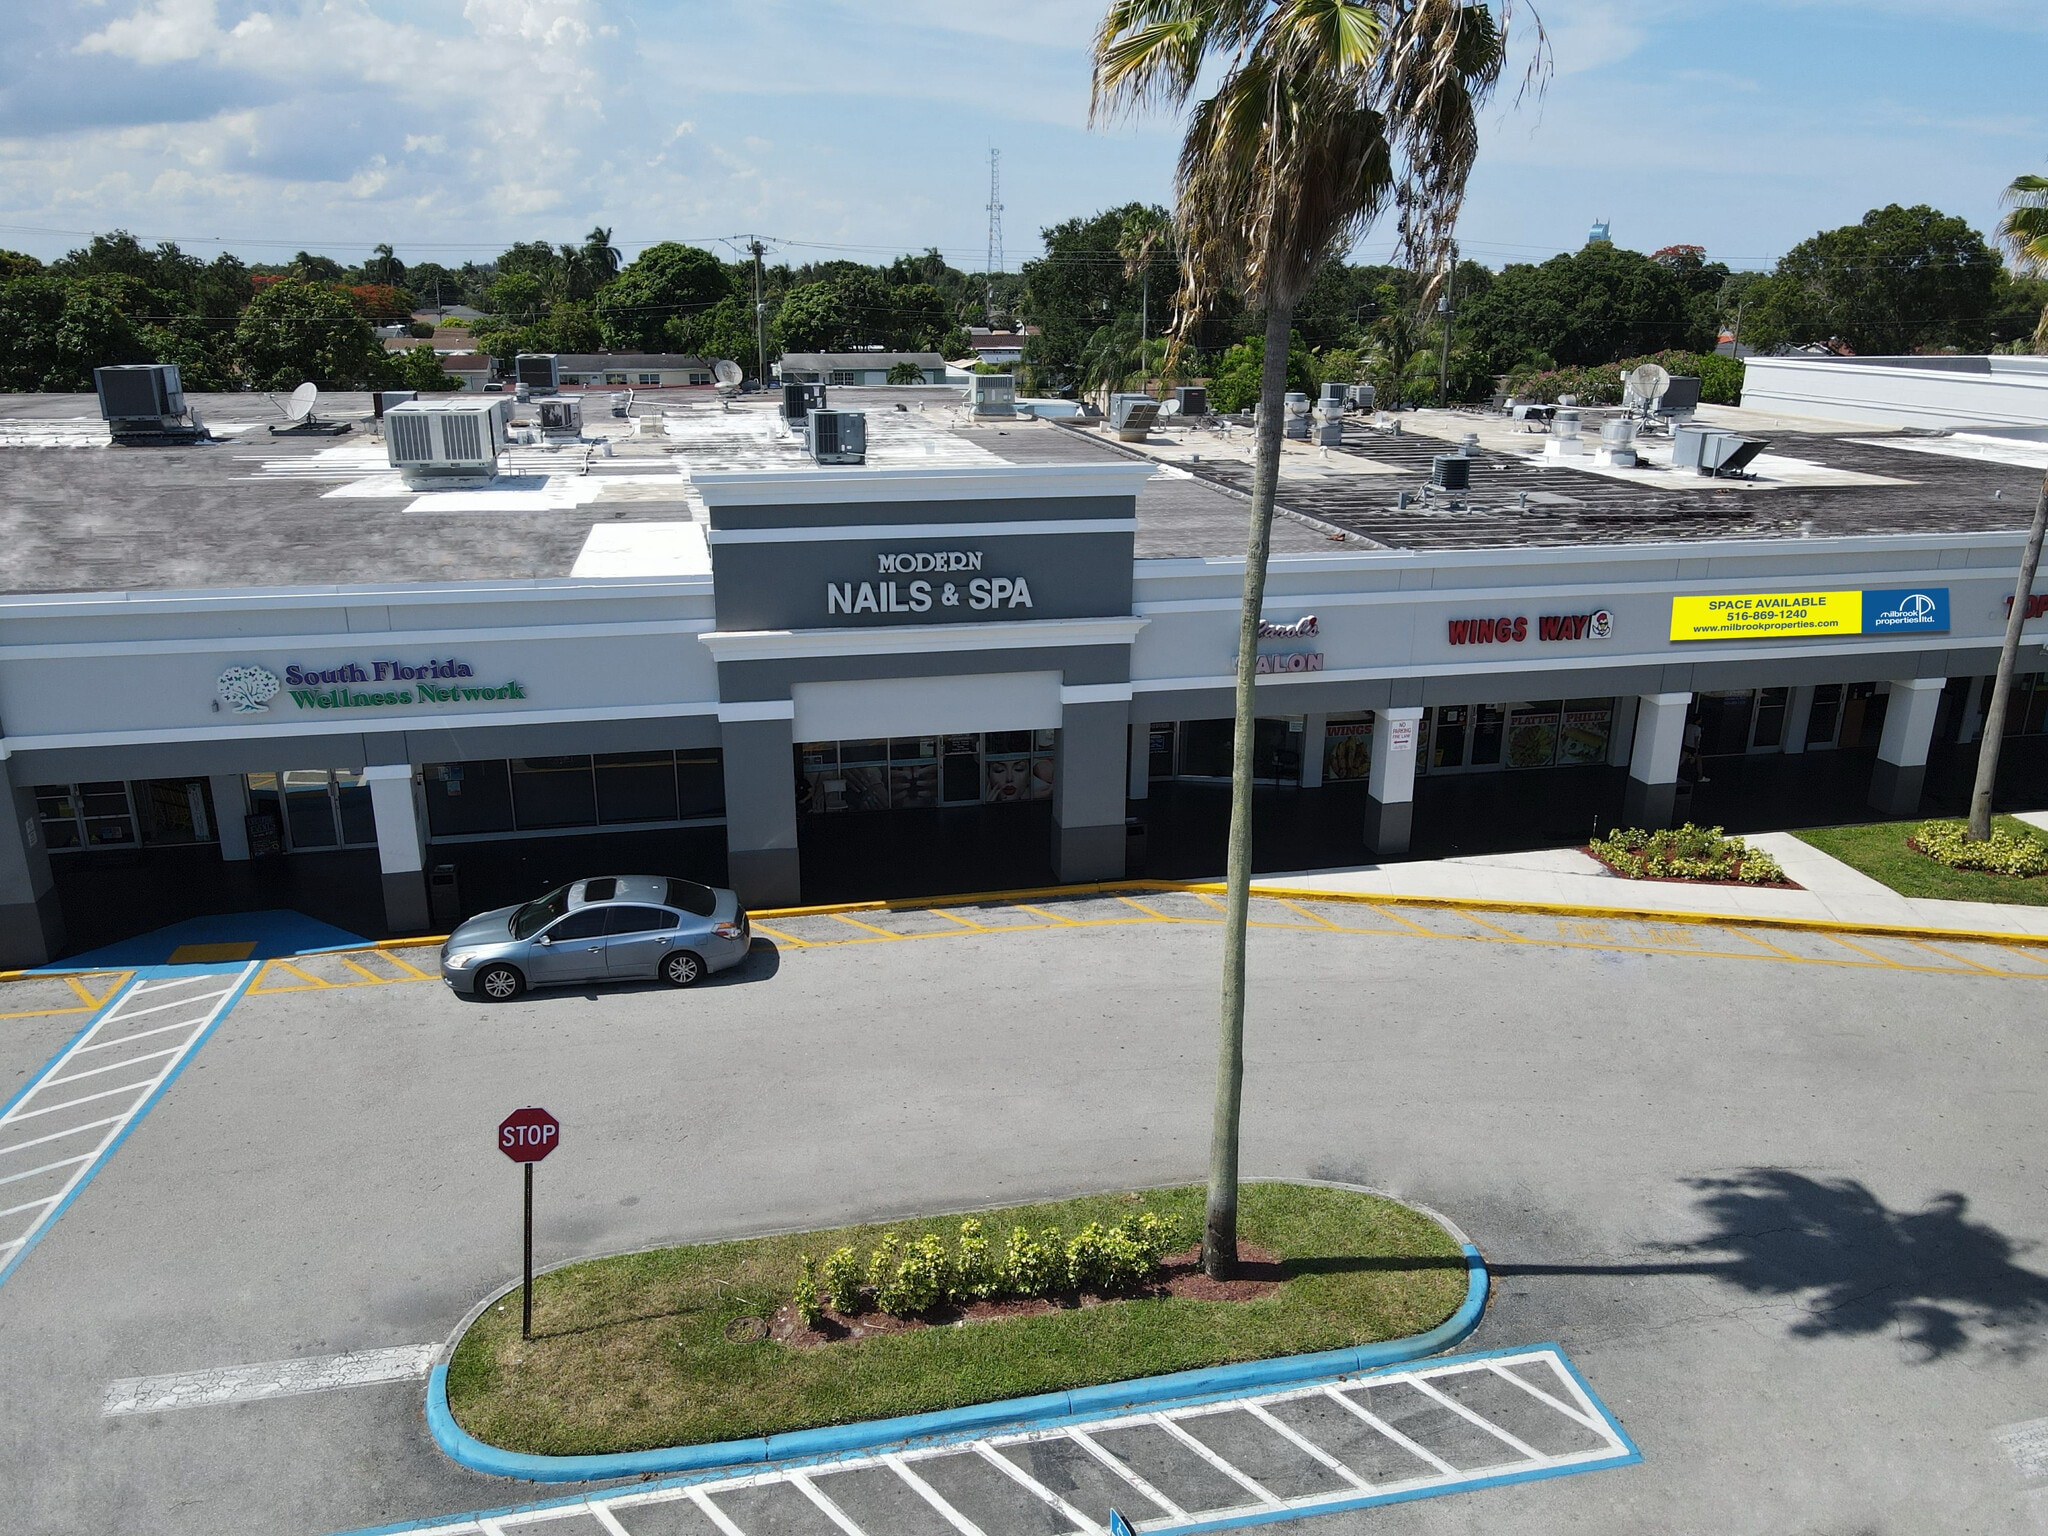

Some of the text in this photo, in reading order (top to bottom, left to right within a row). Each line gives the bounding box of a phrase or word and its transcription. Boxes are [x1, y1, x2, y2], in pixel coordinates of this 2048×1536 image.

[878, 551, 983, 574] MODERN
[827, 577, 1034, 614] NAILS & SPA
[1708, 597, 1827, 611] SPACE AVAILABLE
[1726, 609, 1808, 621] 516-869-1240
[1875, 616, 1919, 626] properties
[1880, 610, 1919, 618] milbrook
[1448, 615, 1588, 646] WINGS WAY
[1693, 619, 1839, 633] www.milbrookproperties.com
[1233, 652, 1324, 674] ALON
[285, 658, 474, 687] South Florida
[287, 680, 527, 710] Wellness Network
[1511, 715, 1557, 726] PLATTER
[1566, 711, 1608, 722] PHILLY
[1327, 725, 1372, 737] WINGS
[1555, 921, 1702, 947] FIRE LANE
[502, 1124, 556, 1147] STOP
